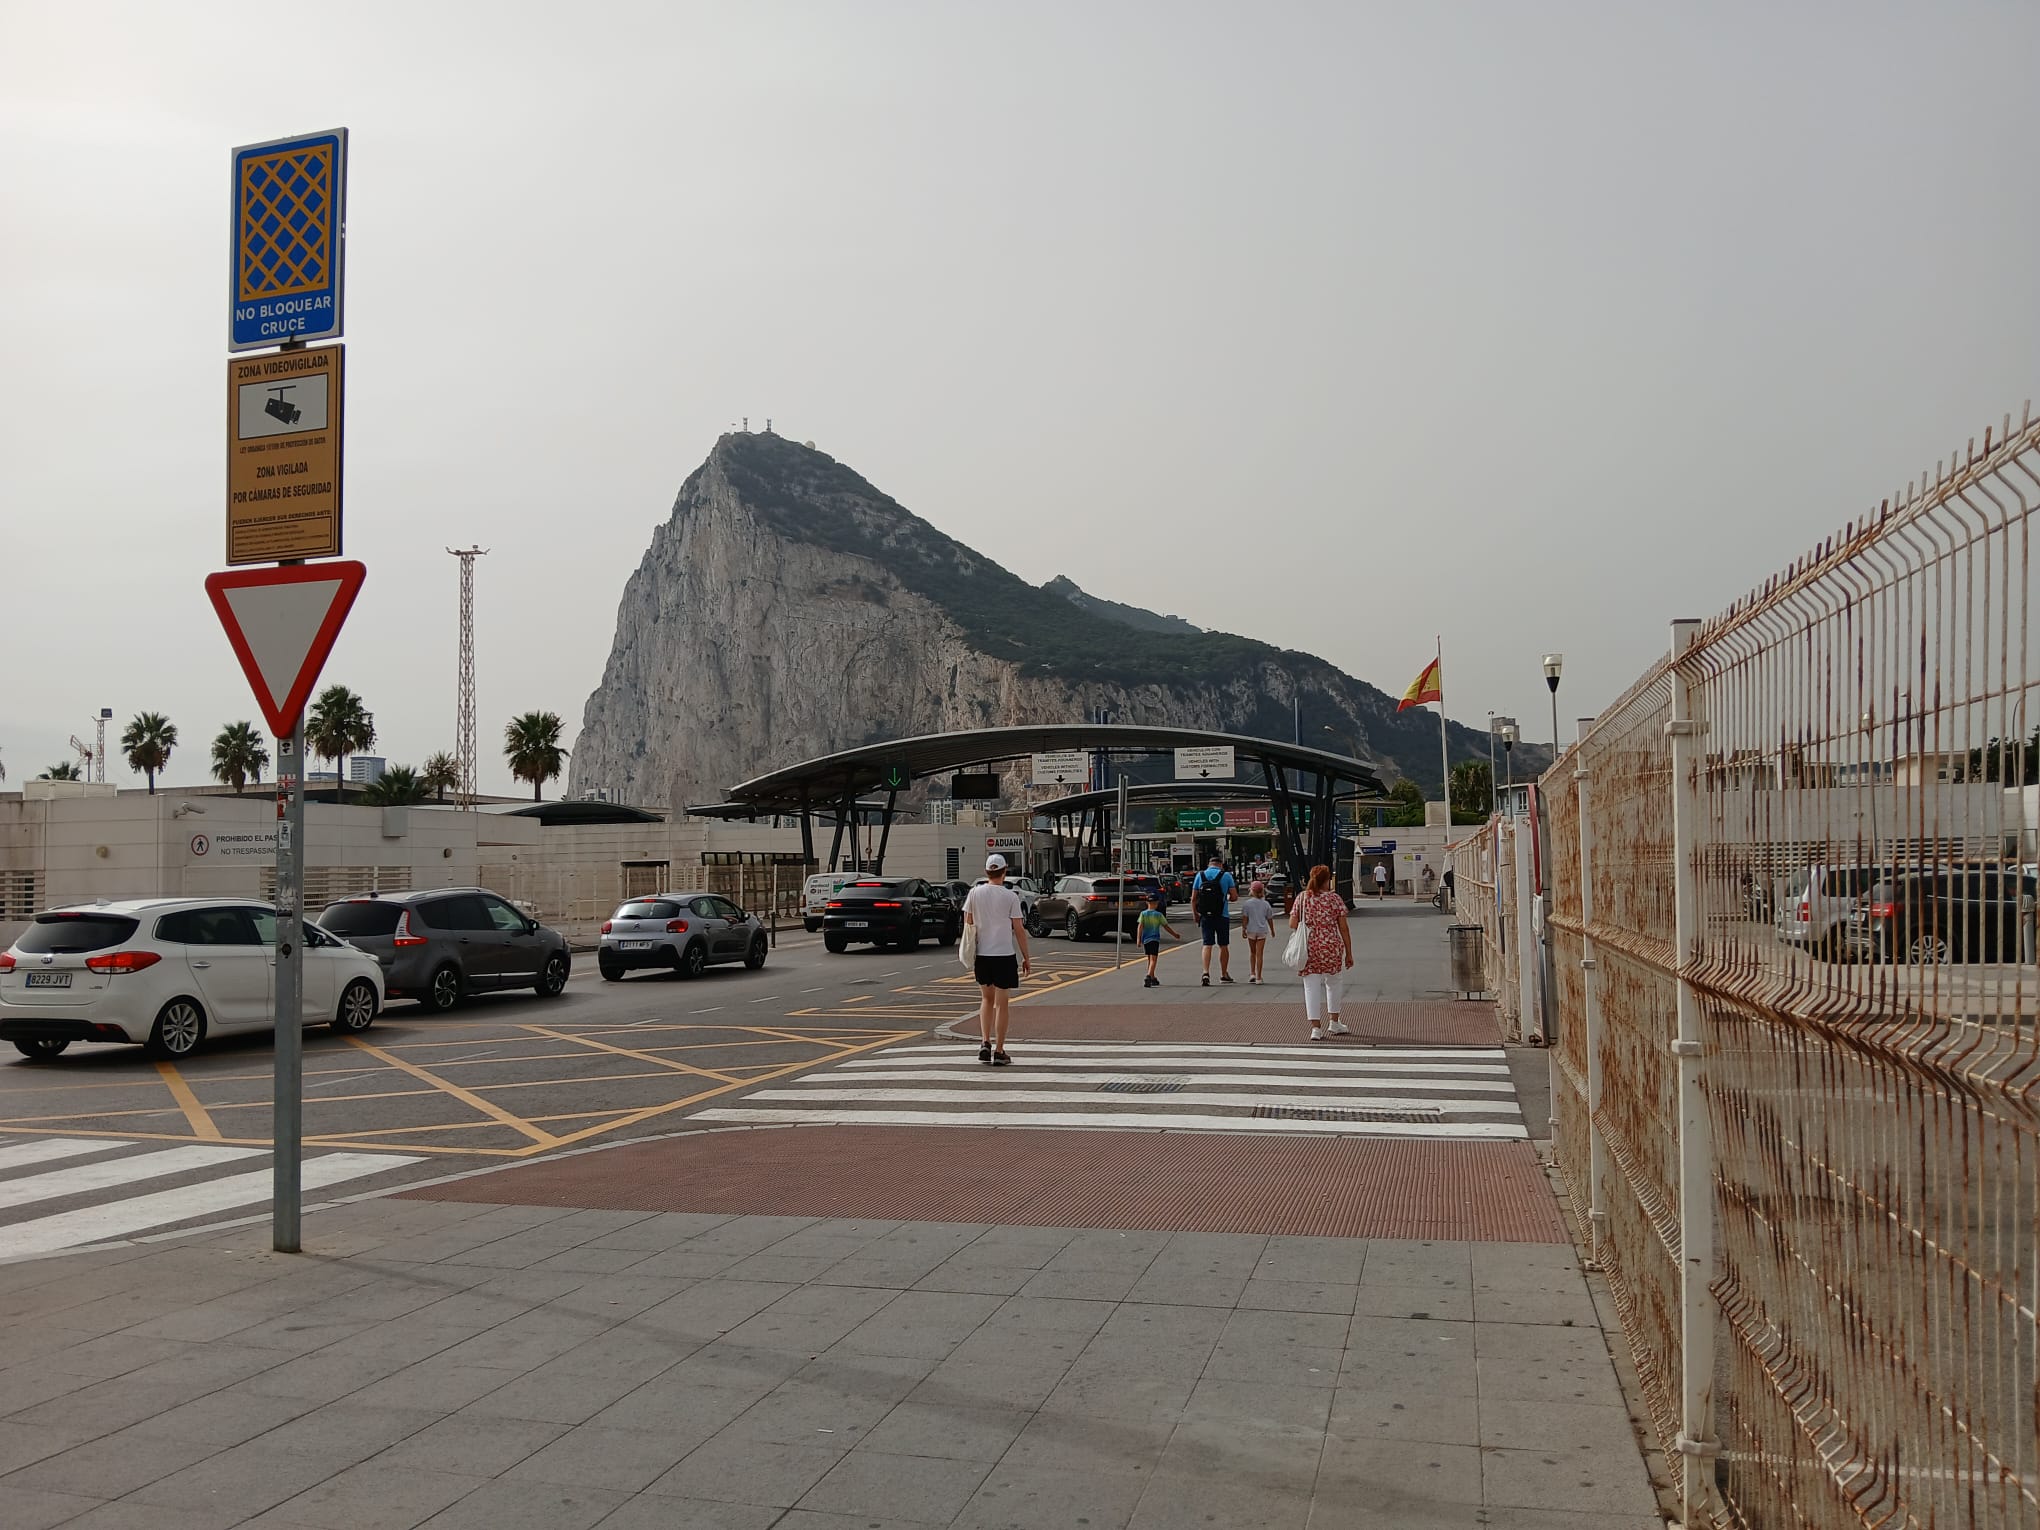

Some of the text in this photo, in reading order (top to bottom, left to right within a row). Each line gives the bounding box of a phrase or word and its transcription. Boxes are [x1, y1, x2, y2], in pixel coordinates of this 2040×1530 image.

[236, 295, 331, 321] NO BLOQUEAR
[261, 317, 306, 335] CRUCE
[238, 355, 329, 379] ZONA VIDEOVIGILADA
[256, 461, 308, 479] ZONA VIGILADA
[233, 491, 247, 504] POR
[282, 486, 292, 498] DE
[292, 481, 332, 497] SEGURIDAD
[216, 835, 253, 843] PROHIBIDO
[264, 834, 279, 842] PAS
[995, 838, 1024, 847] ADUANA
[31, 975, 70, 985] 8229 JVT
